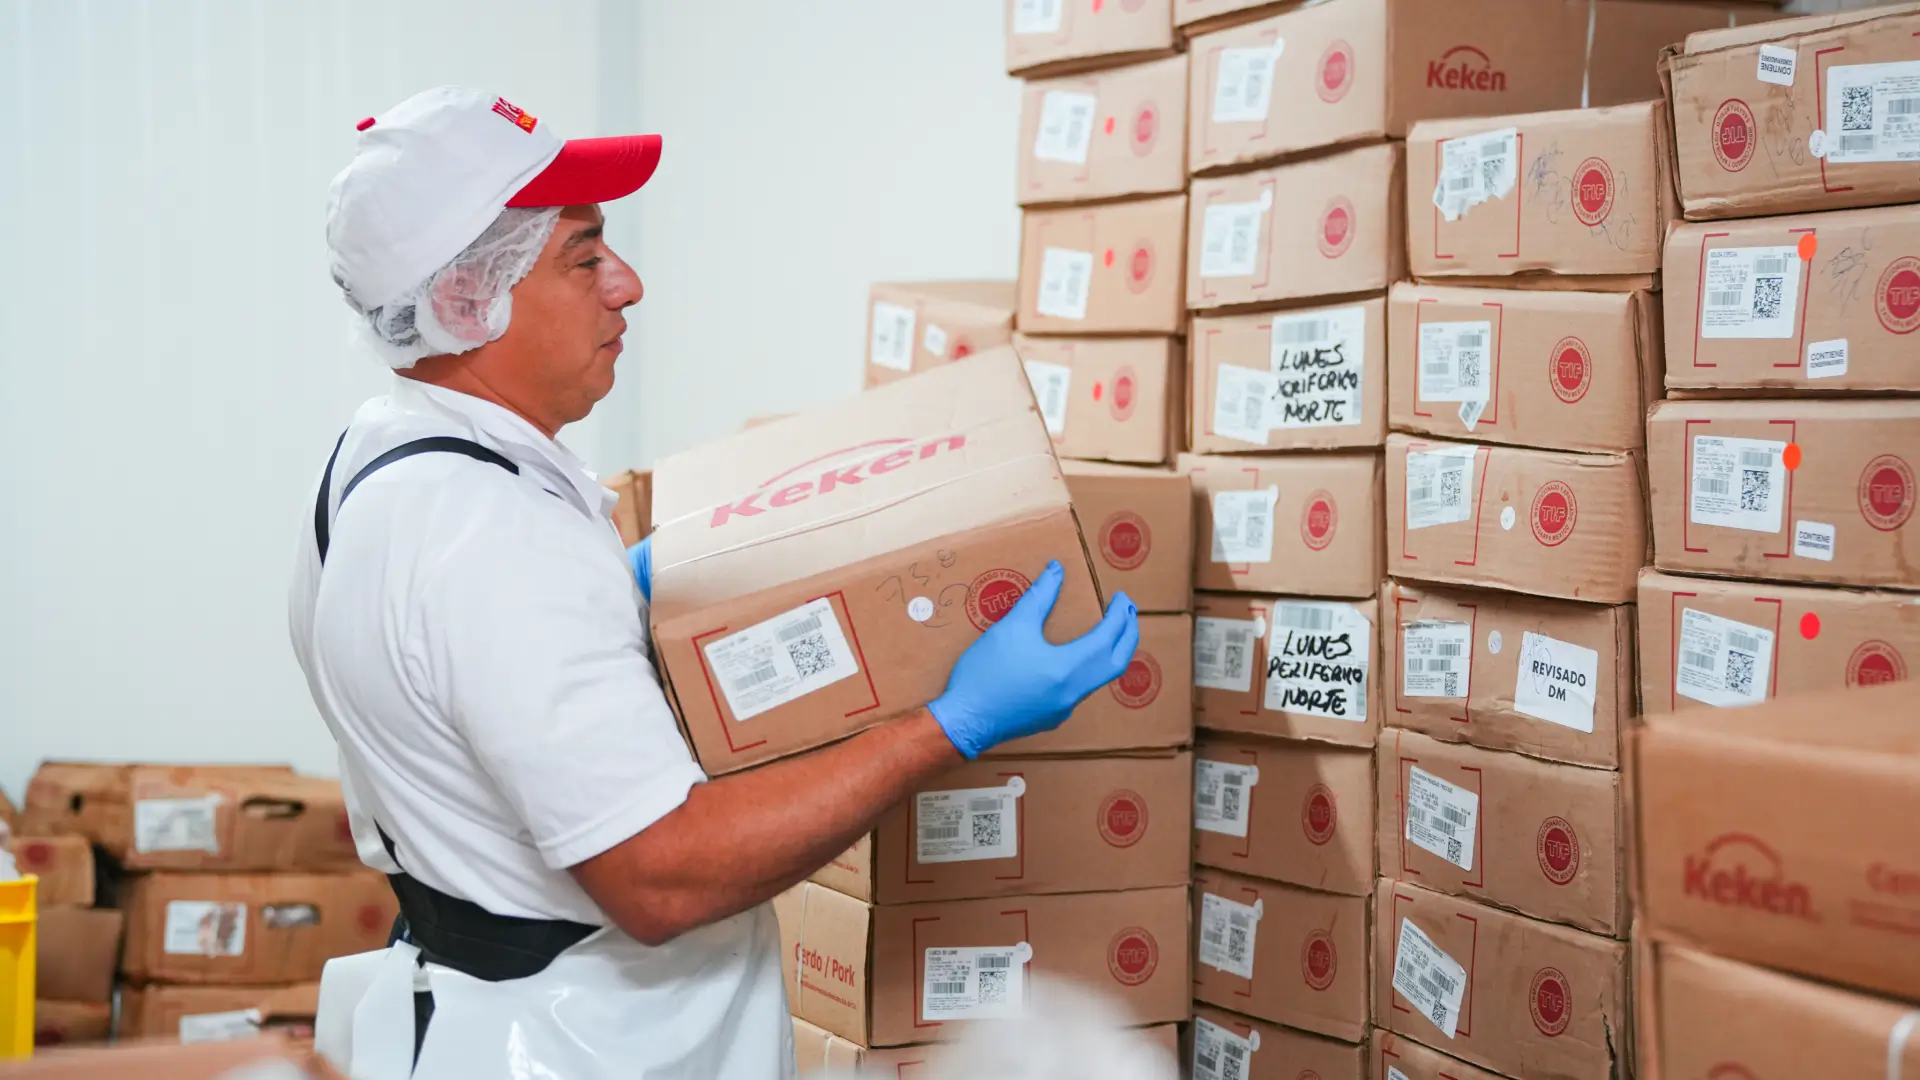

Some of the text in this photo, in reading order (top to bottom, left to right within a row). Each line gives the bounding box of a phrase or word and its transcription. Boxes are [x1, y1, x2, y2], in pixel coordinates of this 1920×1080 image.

[1761, 62, 1792, 75] CONTIENE
[1722, 126, 1746, 145] TIF
[1581, 184, 1605, 201] TIF
[1889, 287, 1920, 306] TIF
[1279, 343, 1344, 371] LUNES
[1810, 349, 1844, 361] CONTIENE
[1560, 362, 1581, 379] TIF
[1284, 399, 1346, 423] NORTE
[1541, 505, 1566, 523] TIF
[1798, 530, 1831, 545] CONTIENE
[982, 588, 1019, 613] TIF
[1283, 630, 1352, 661] LUNES
[1532, 660, 1586, 687] REVISADO
[1281, 686, 1347, 715] NORTE
[1548, 684, 1566, 702] DM
[1547, 839, 1569, 860] TIF
[832, 958, 856, 987] Pork
[1540, 990, 1563, 1013] TIF
